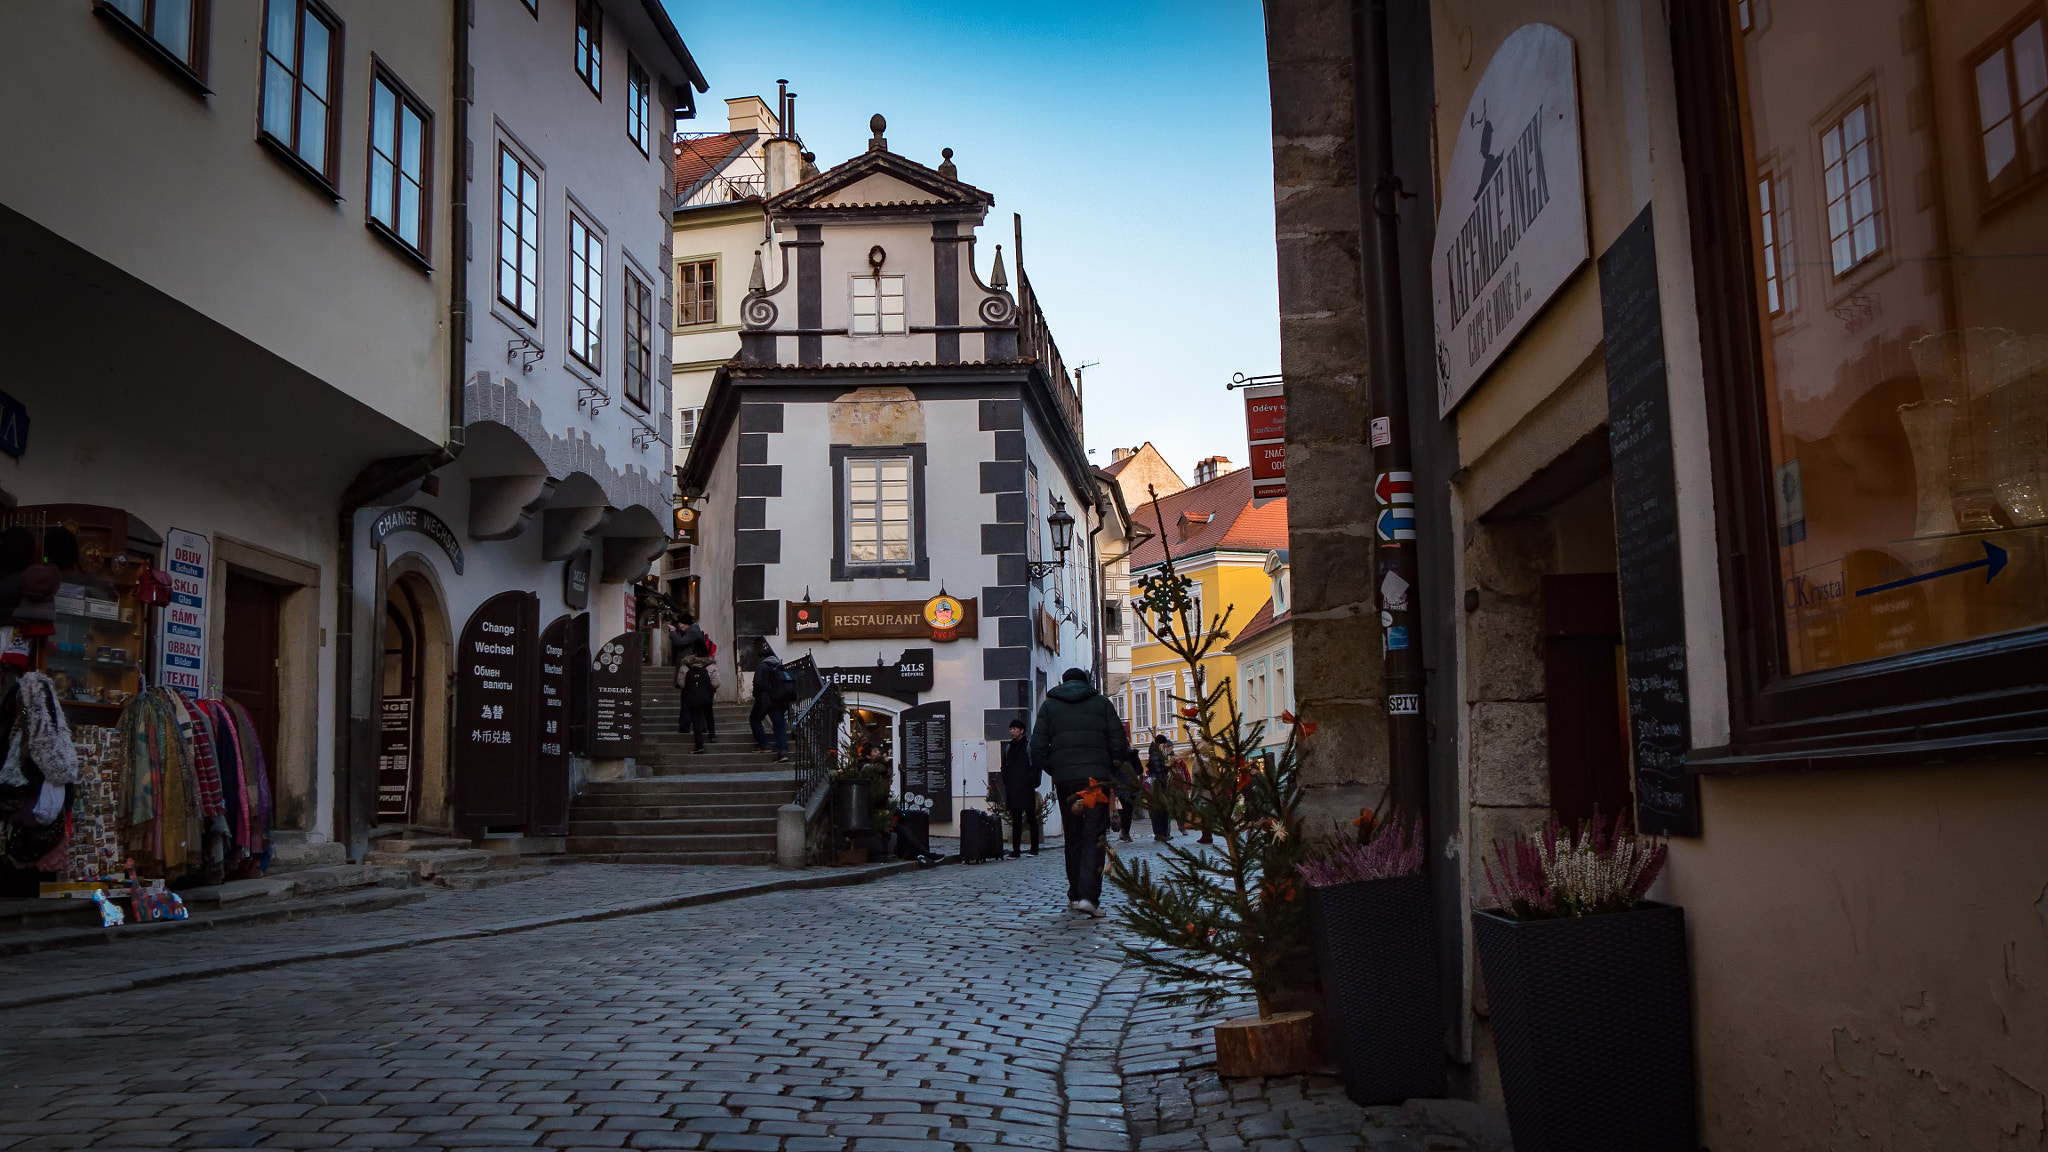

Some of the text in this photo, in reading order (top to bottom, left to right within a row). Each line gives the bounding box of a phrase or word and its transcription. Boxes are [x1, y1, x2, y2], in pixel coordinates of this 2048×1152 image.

[1446, 104, 1550, 332] KAFEMLEJNEK
[1492, 274, 1515, 336] WINE
[1252, 404, 1278, 413] Oděvy
[1264, 446, 1286, 459] ZNAČ
[378, 510, 460, 563] CHANGE WECHSEL
[175, 548, 202, 565] OBUV
[173, 578, 199, 595] SKLO
[178, 594, 192, 605] Glas
[171, 608, 198, 626] RÁMY
[833, 613, 921, 627] RESTAURANT
[482, 621, 515, 636] Change
[168, 640, 202, 657] OBRAZY
[475, 641, 514, 656] Wechsel
[174, 656, 193, 667] Bilder
[901, 663, 925, 672] MLS
[474, 664, 501, 678] Обмен
[166, 670, 200, 688] TEXTIL
[482, 680, 513, 691] валюты
[481, 704, 504, 720] 為替
